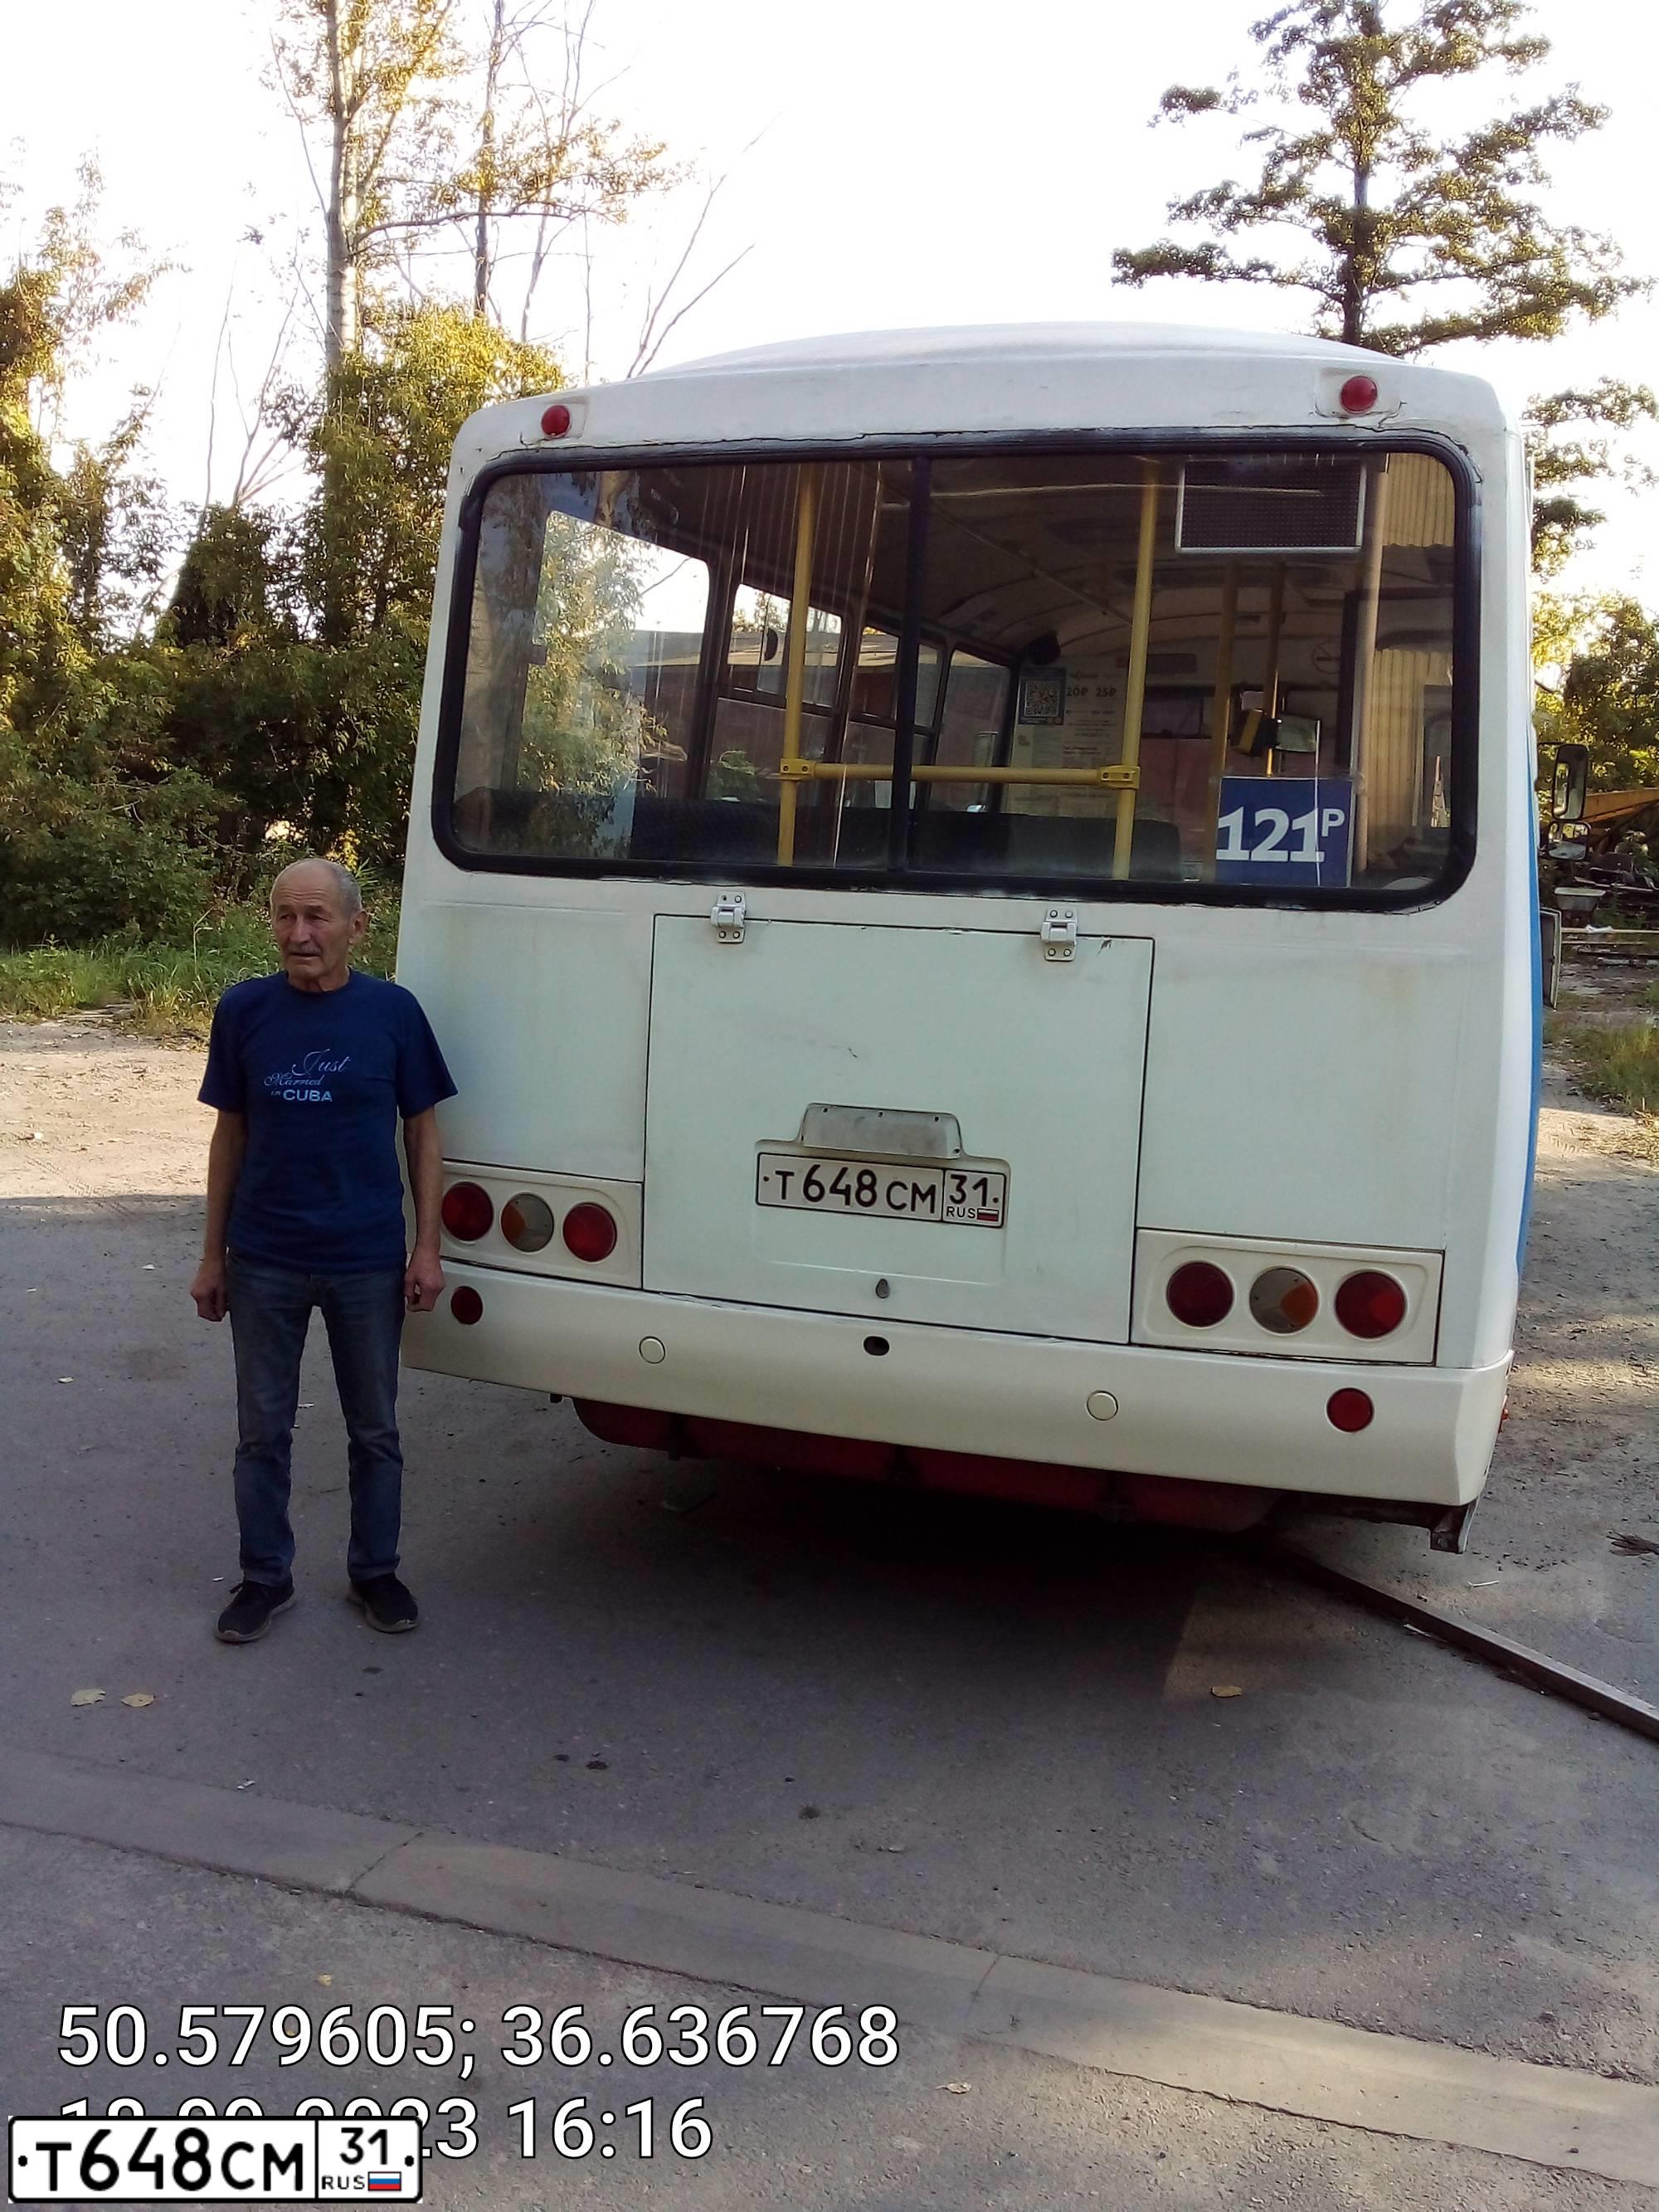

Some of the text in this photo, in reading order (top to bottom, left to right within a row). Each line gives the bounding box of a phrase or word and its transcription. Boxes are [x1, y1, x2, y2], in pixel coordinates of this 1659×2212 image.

[292, 1048, 351, 1076] Just
[264, 1072, 325, 1086] Married
[283, 1089, 333, 1102] CUBA
[949, 1174, 990, 1207] 31
[946, 1207, 976, 1220] RUS
